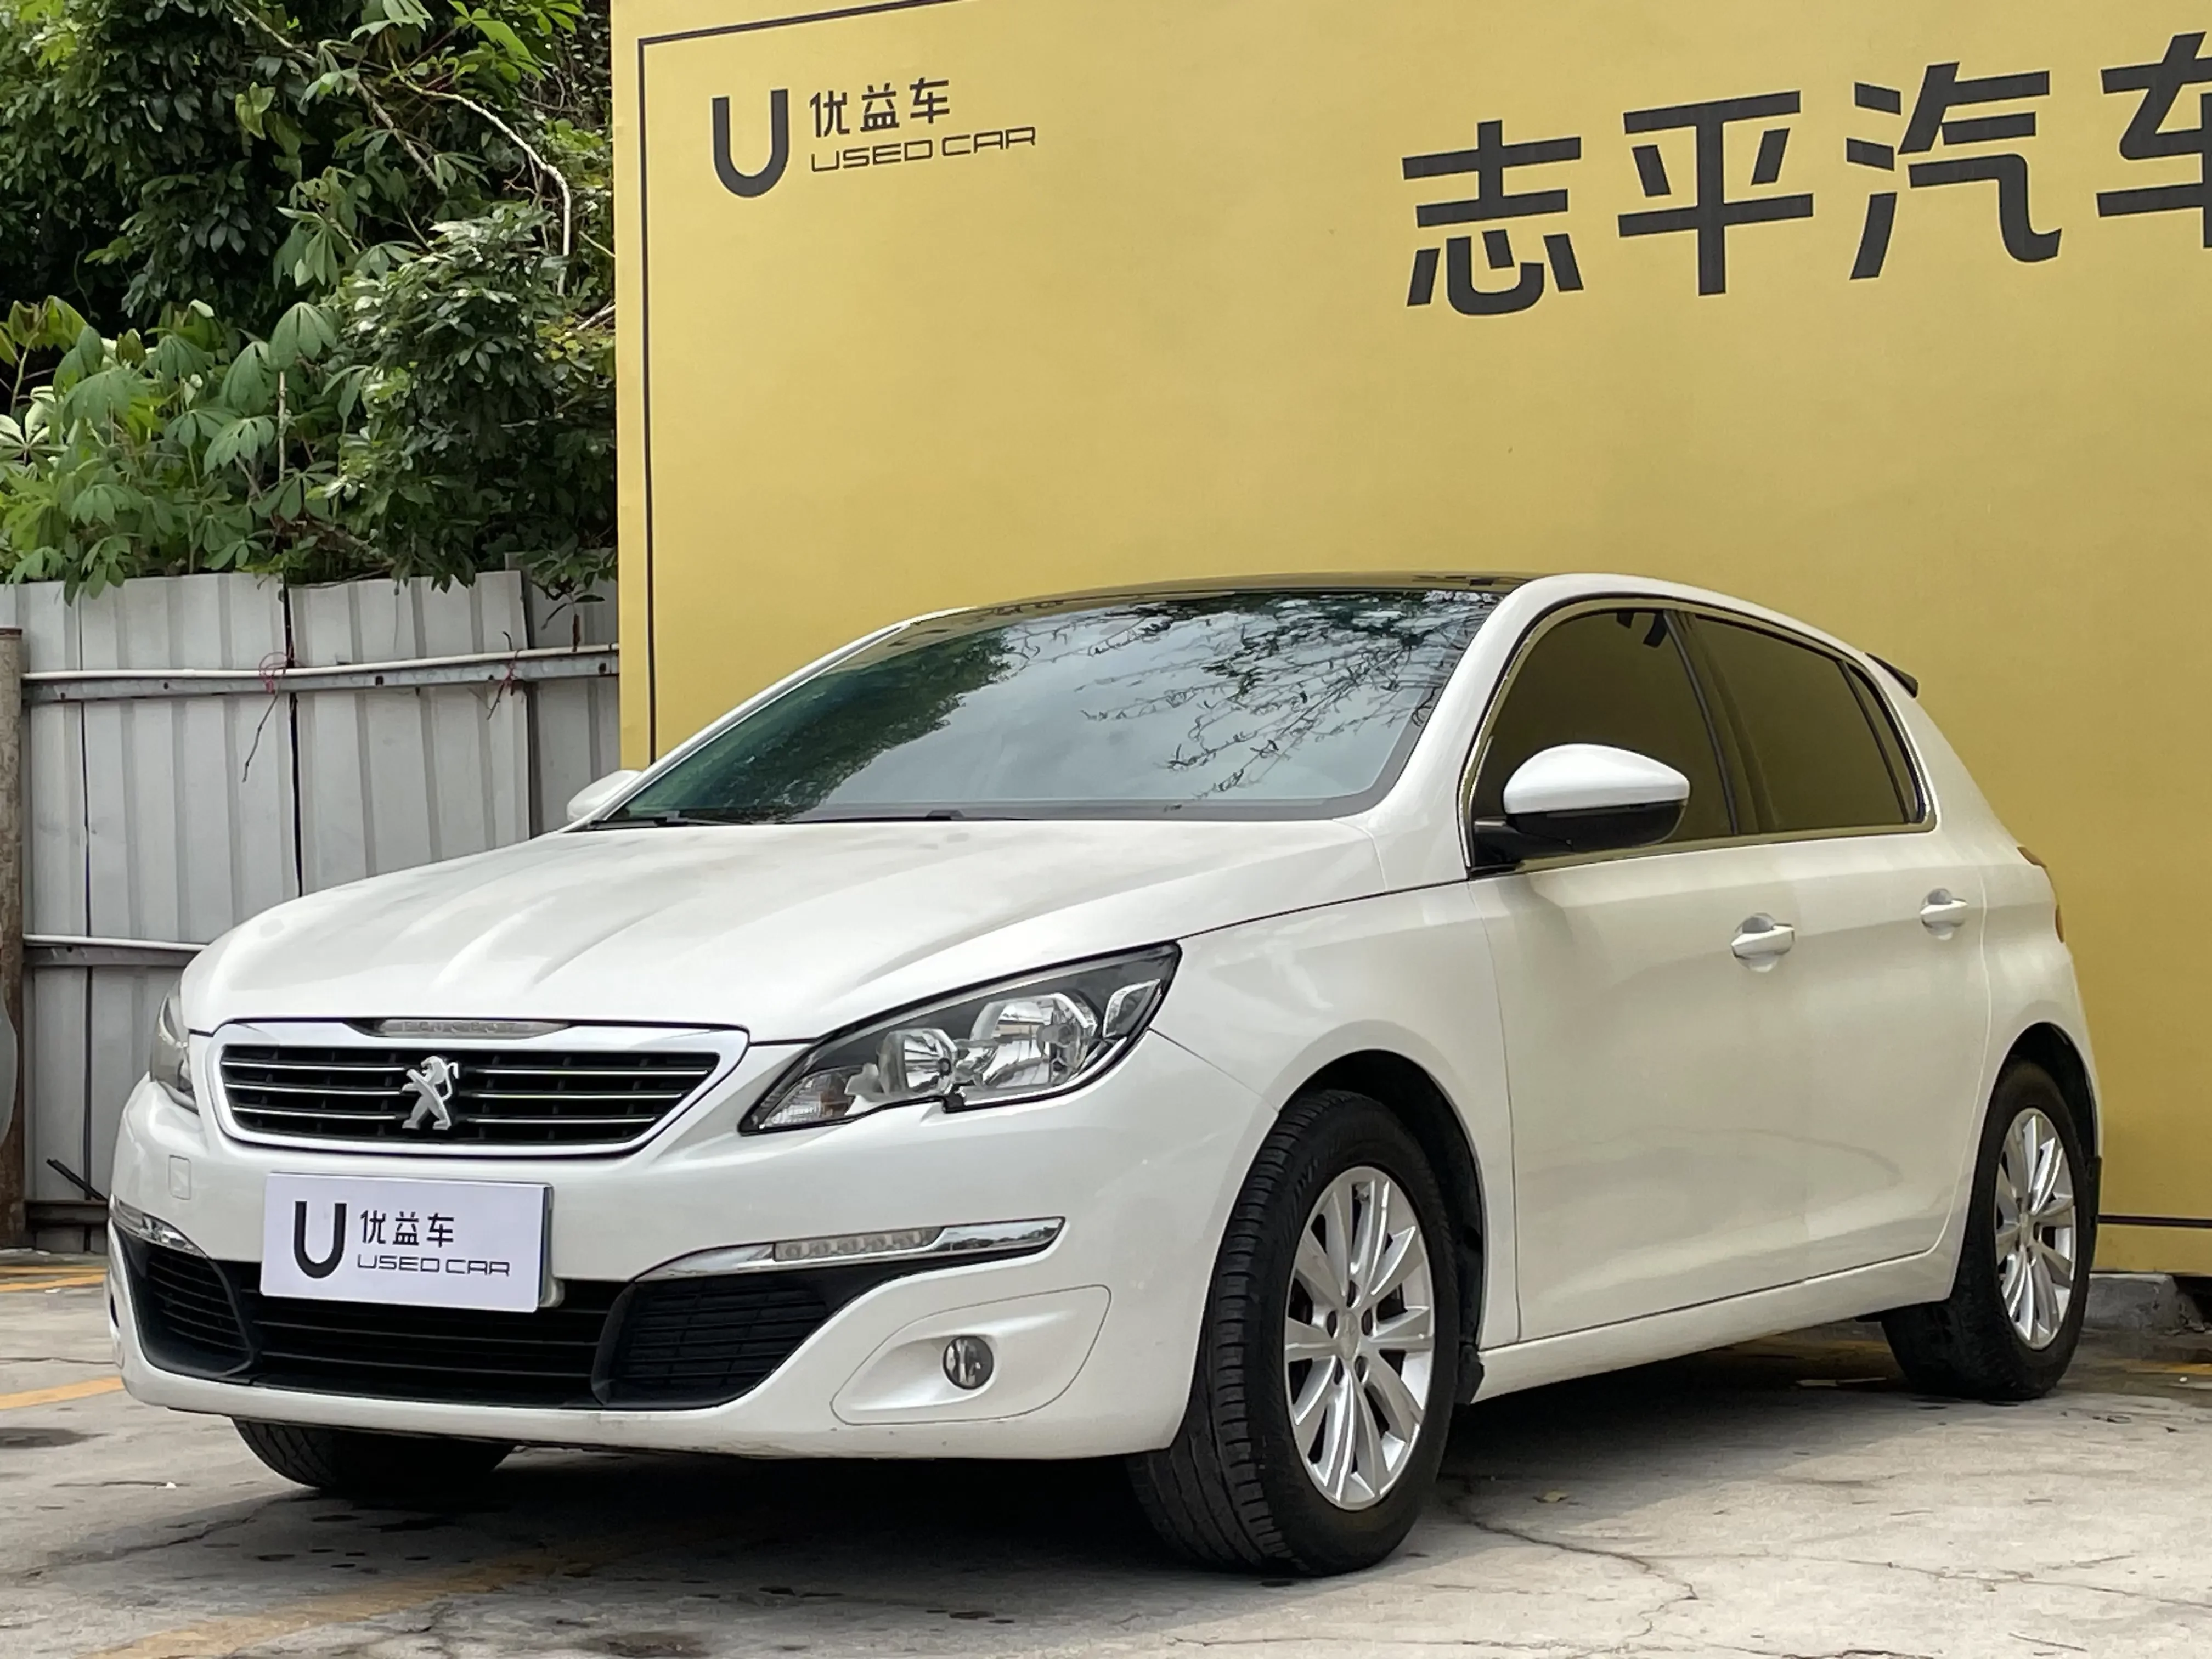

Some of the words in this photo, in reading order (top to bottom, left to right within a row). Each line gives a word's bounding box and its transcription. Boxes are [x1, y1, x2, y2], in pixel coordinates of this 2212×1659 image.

[810, 77, 950, 138] 优益车
[712, 88, 789, 198] U
[811, 139, 933, 172] USED
[941, 127, 1036, 156] CAR
[1402, 32, 2212, 316] 志平汽车
[294, 1201, 347, 1279] U
[360, 1210, 455, 1248] 优益车
[357, 1254, 439, 1273] USED
[445, 1259, 510, 1277] CAR
